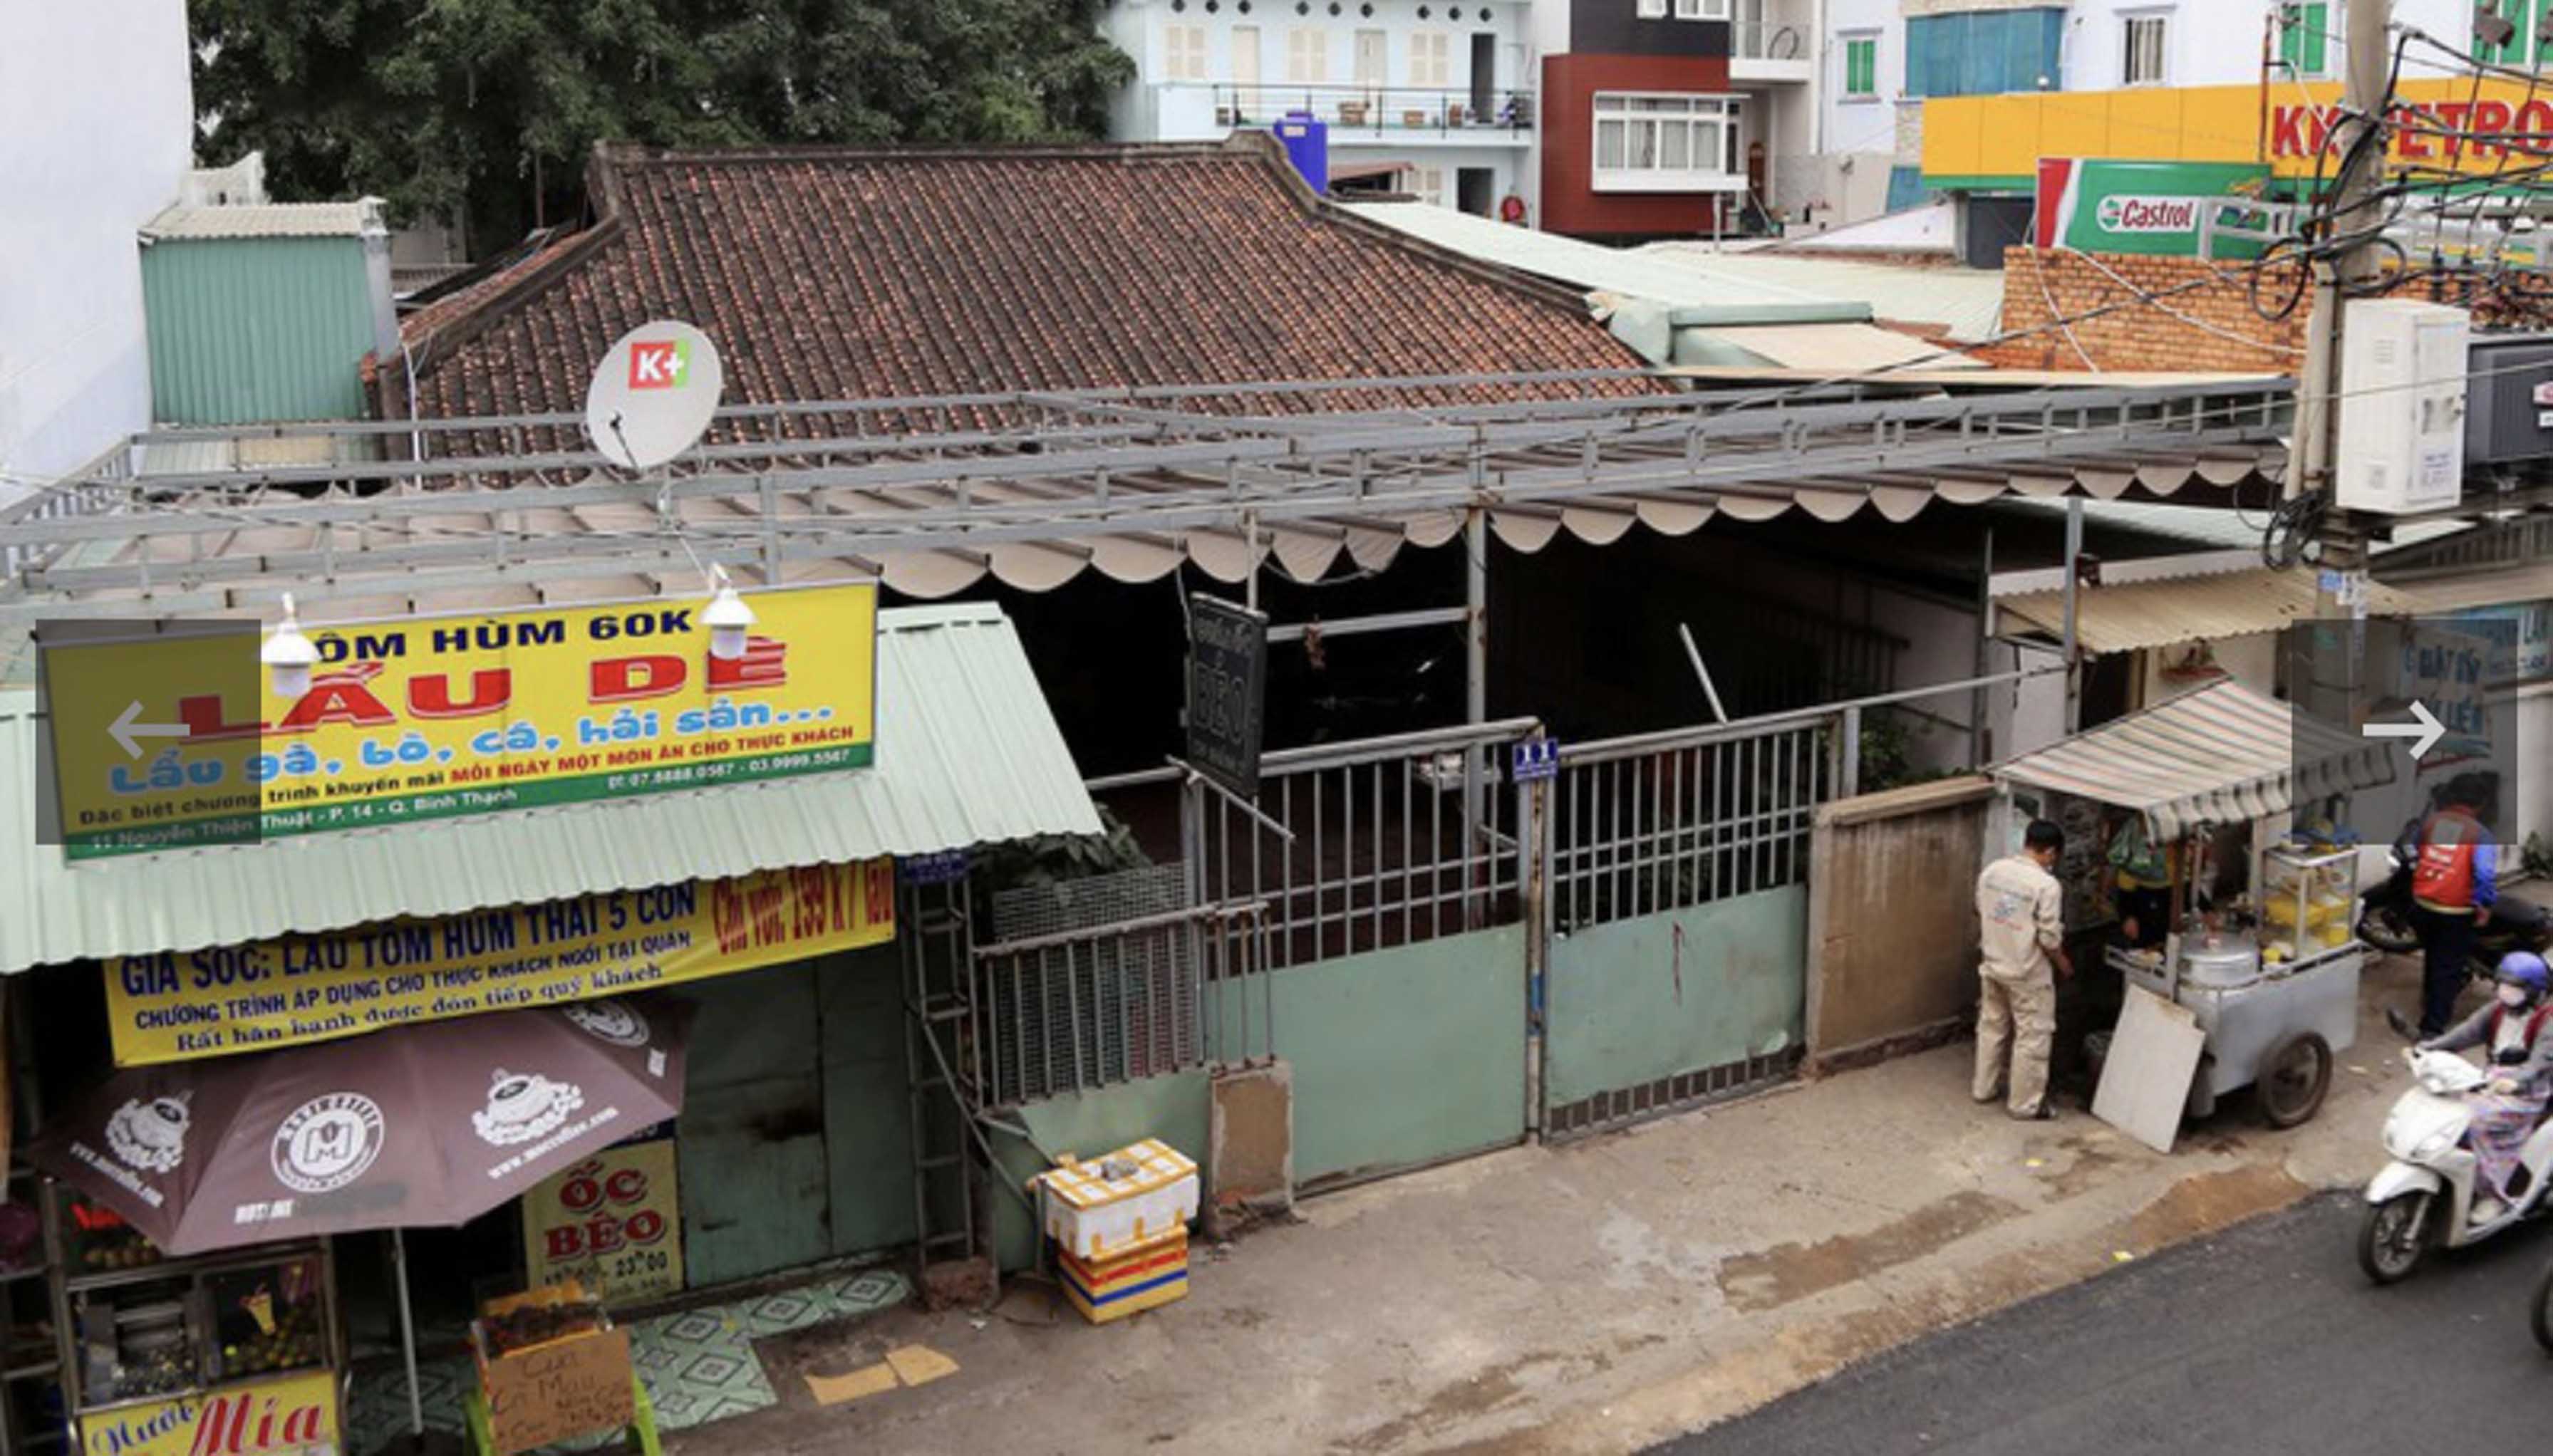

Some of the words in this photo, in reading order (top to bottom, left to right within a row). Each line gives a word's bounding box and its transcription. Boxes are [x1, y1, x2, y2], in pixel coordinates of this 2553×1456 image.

[2398, 100, 2553, 157] ETRO
[2122, 199, 2192, 228] Castrol
[638, 350, 684, 380] K+
[314, 631, 407, 664] ÔM
[433, 617, 566, 653] HÙM
[589, 609, 692, 640] 60K
[579, 707, 659, 746] hải
[690, 740, 730, 757] CHO
[353, 804, 373, 818] 14
[609, 893, 627, 930] 5
[326, 979, 381, 1005] DỤNG
[385, 973, 425, 995] CHO
